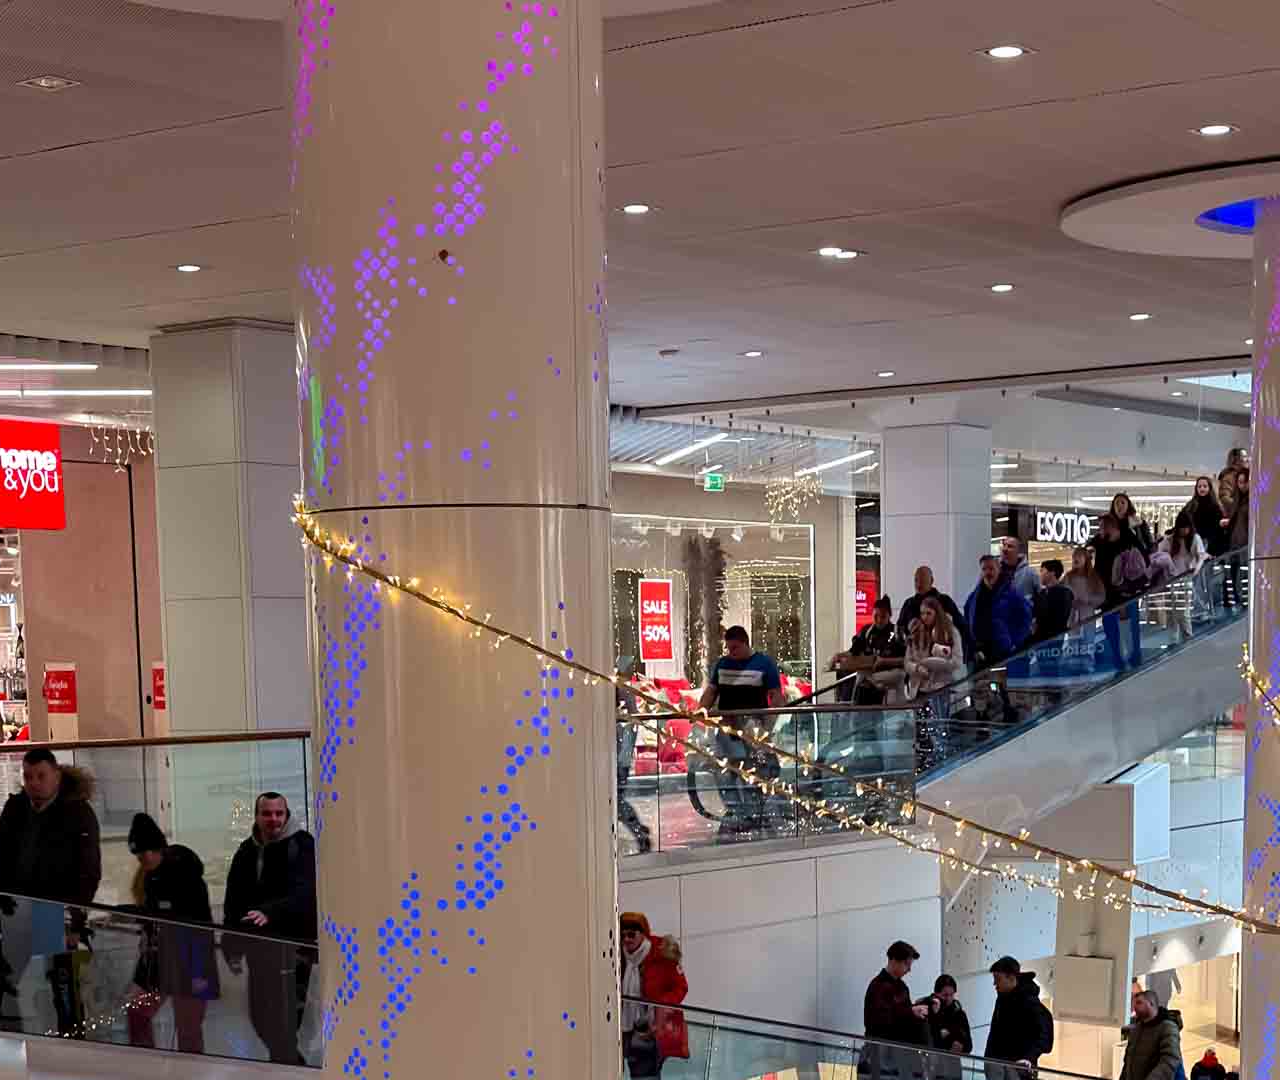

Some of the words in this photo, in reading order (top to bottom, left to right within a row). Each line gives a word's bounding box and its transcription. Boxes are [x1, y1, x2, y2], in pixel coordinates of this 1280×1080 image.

[4, 468, 59, 499] &you
[1036, 511, 1091, 545] ESOTIQ
[642, 600, 668, 614] SALE
[642, 625, 670, 641] -50%
